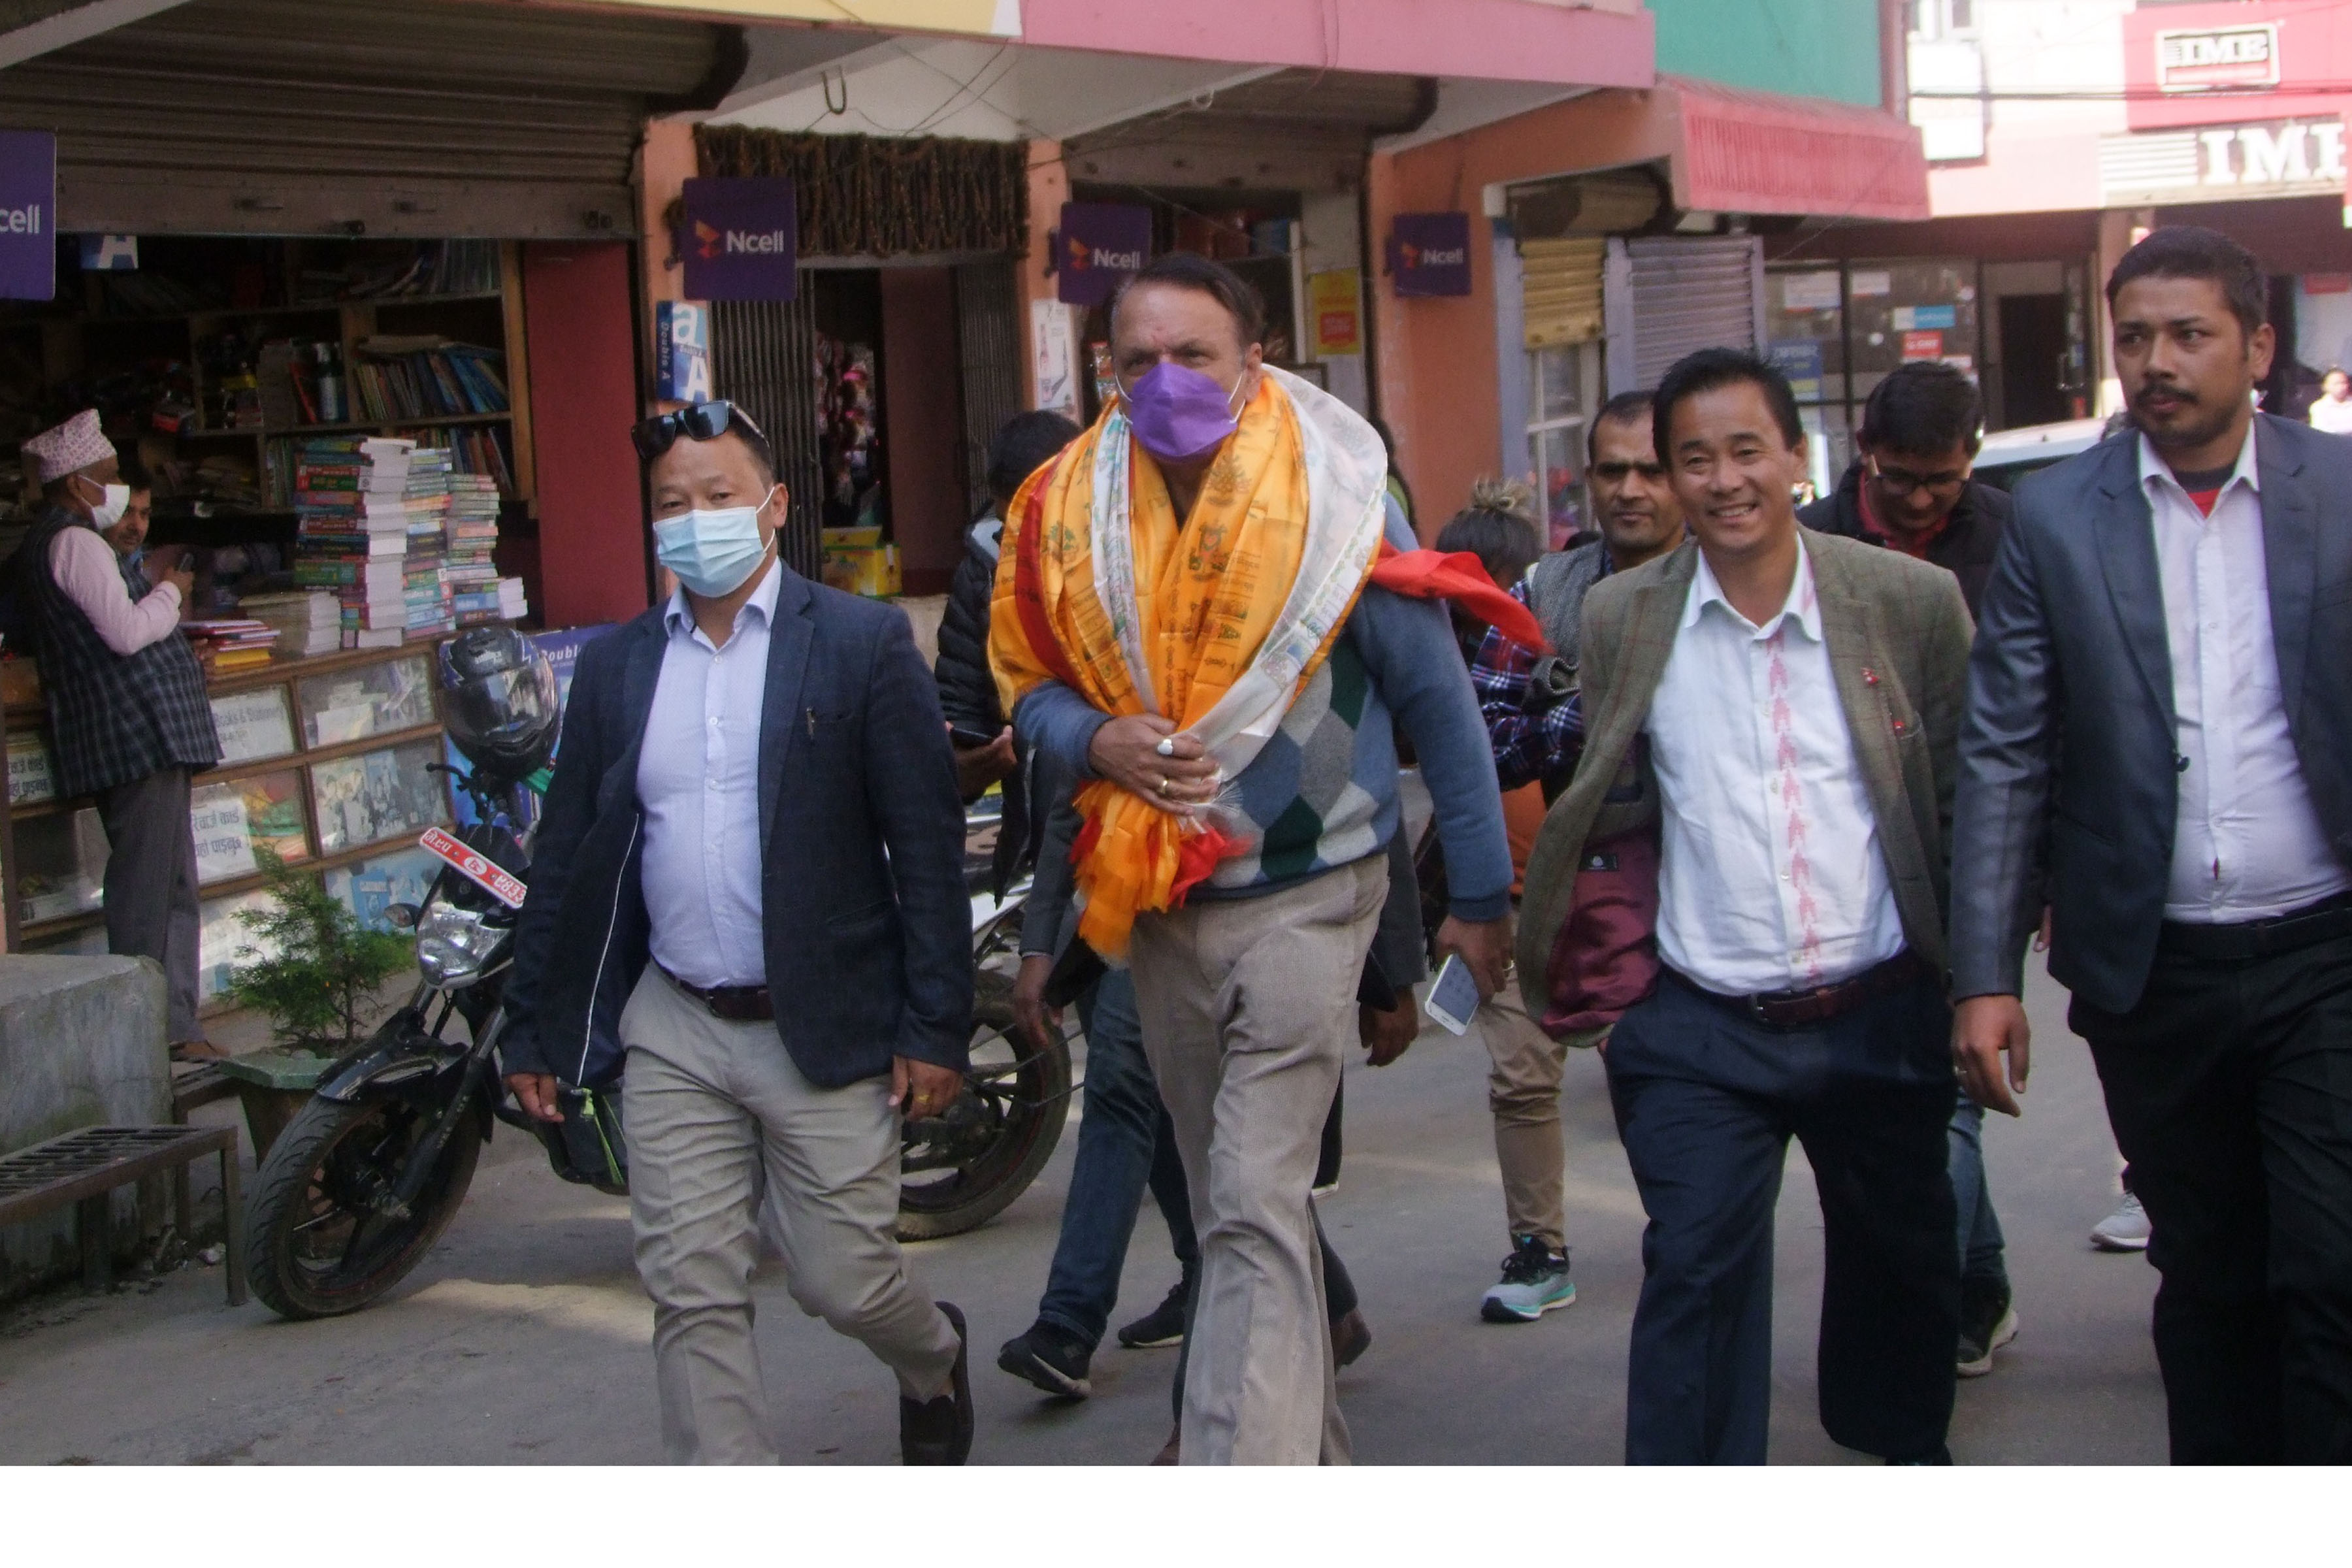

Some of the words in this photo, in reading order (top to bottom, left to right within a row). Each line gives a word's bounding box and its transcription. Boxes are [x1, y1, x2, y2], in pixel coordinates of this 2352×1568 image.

[2181, 33, 2268, 65] IME
[727, 230, 784, 253] Ncell
[1094, 248, 1140, 270] Ncell
[1424, 248, 1463, 264] Ncell
[661, 321, 670, 367] Double
[661, 371, 671, 380] A
